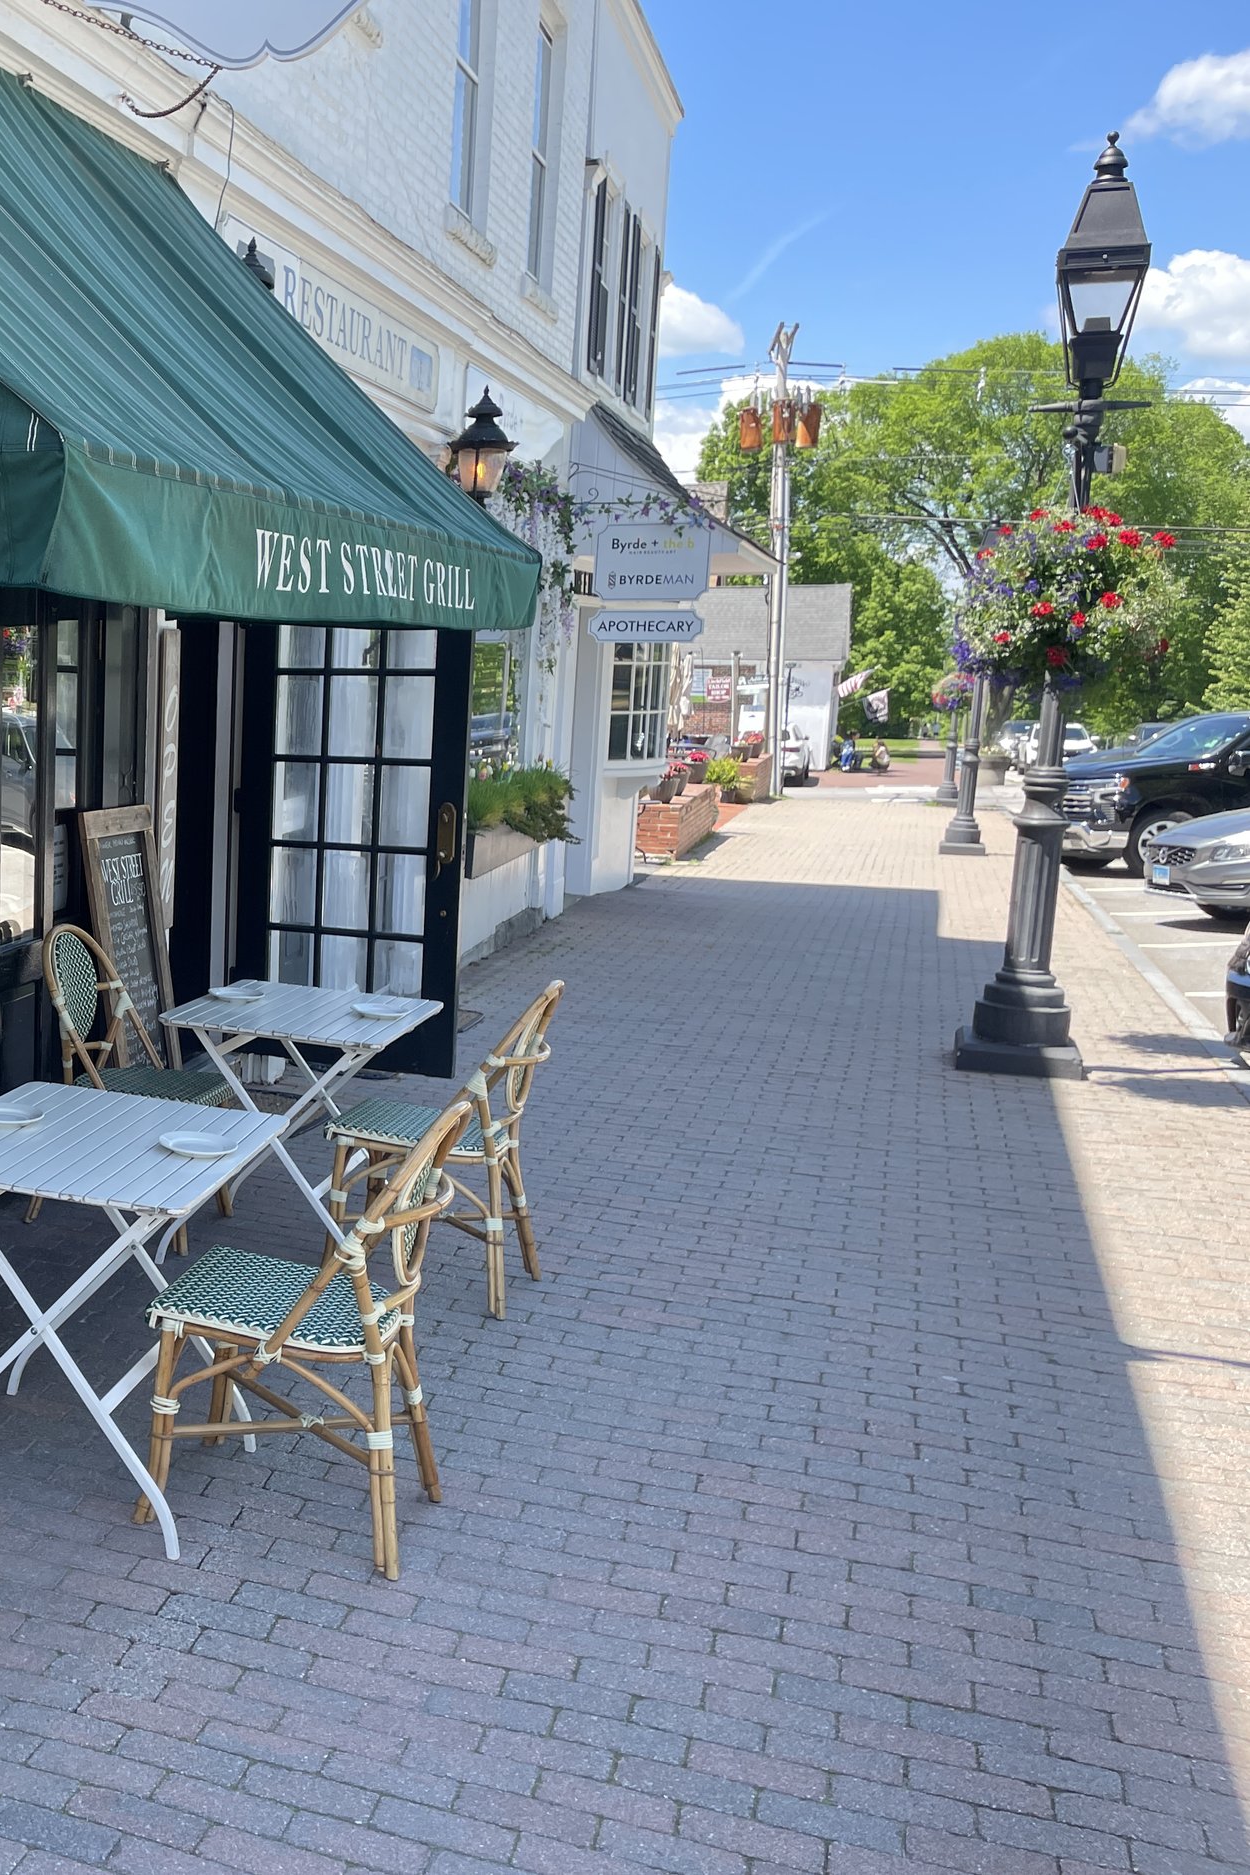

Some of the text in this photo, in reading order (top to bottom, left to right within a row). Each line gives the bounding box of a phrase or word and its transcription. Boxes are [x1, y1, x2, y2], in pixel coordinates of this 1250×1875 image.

[283, 264, 407, 380] RESTAURANT
[611, 538, 647, 553] Byrde
[663, 538, 684, 549] the
[255, 528, 476, 610] WEST STREET GRILL
[619, 574, 695, 585] BYRDEMAN
[597, 620, 695, 632] APOTHECARY
[161, 684, 179, 904] OPEN
[100, 852, 144, 883] WEST STREET
[110, 877, 134, 906] GRILL
